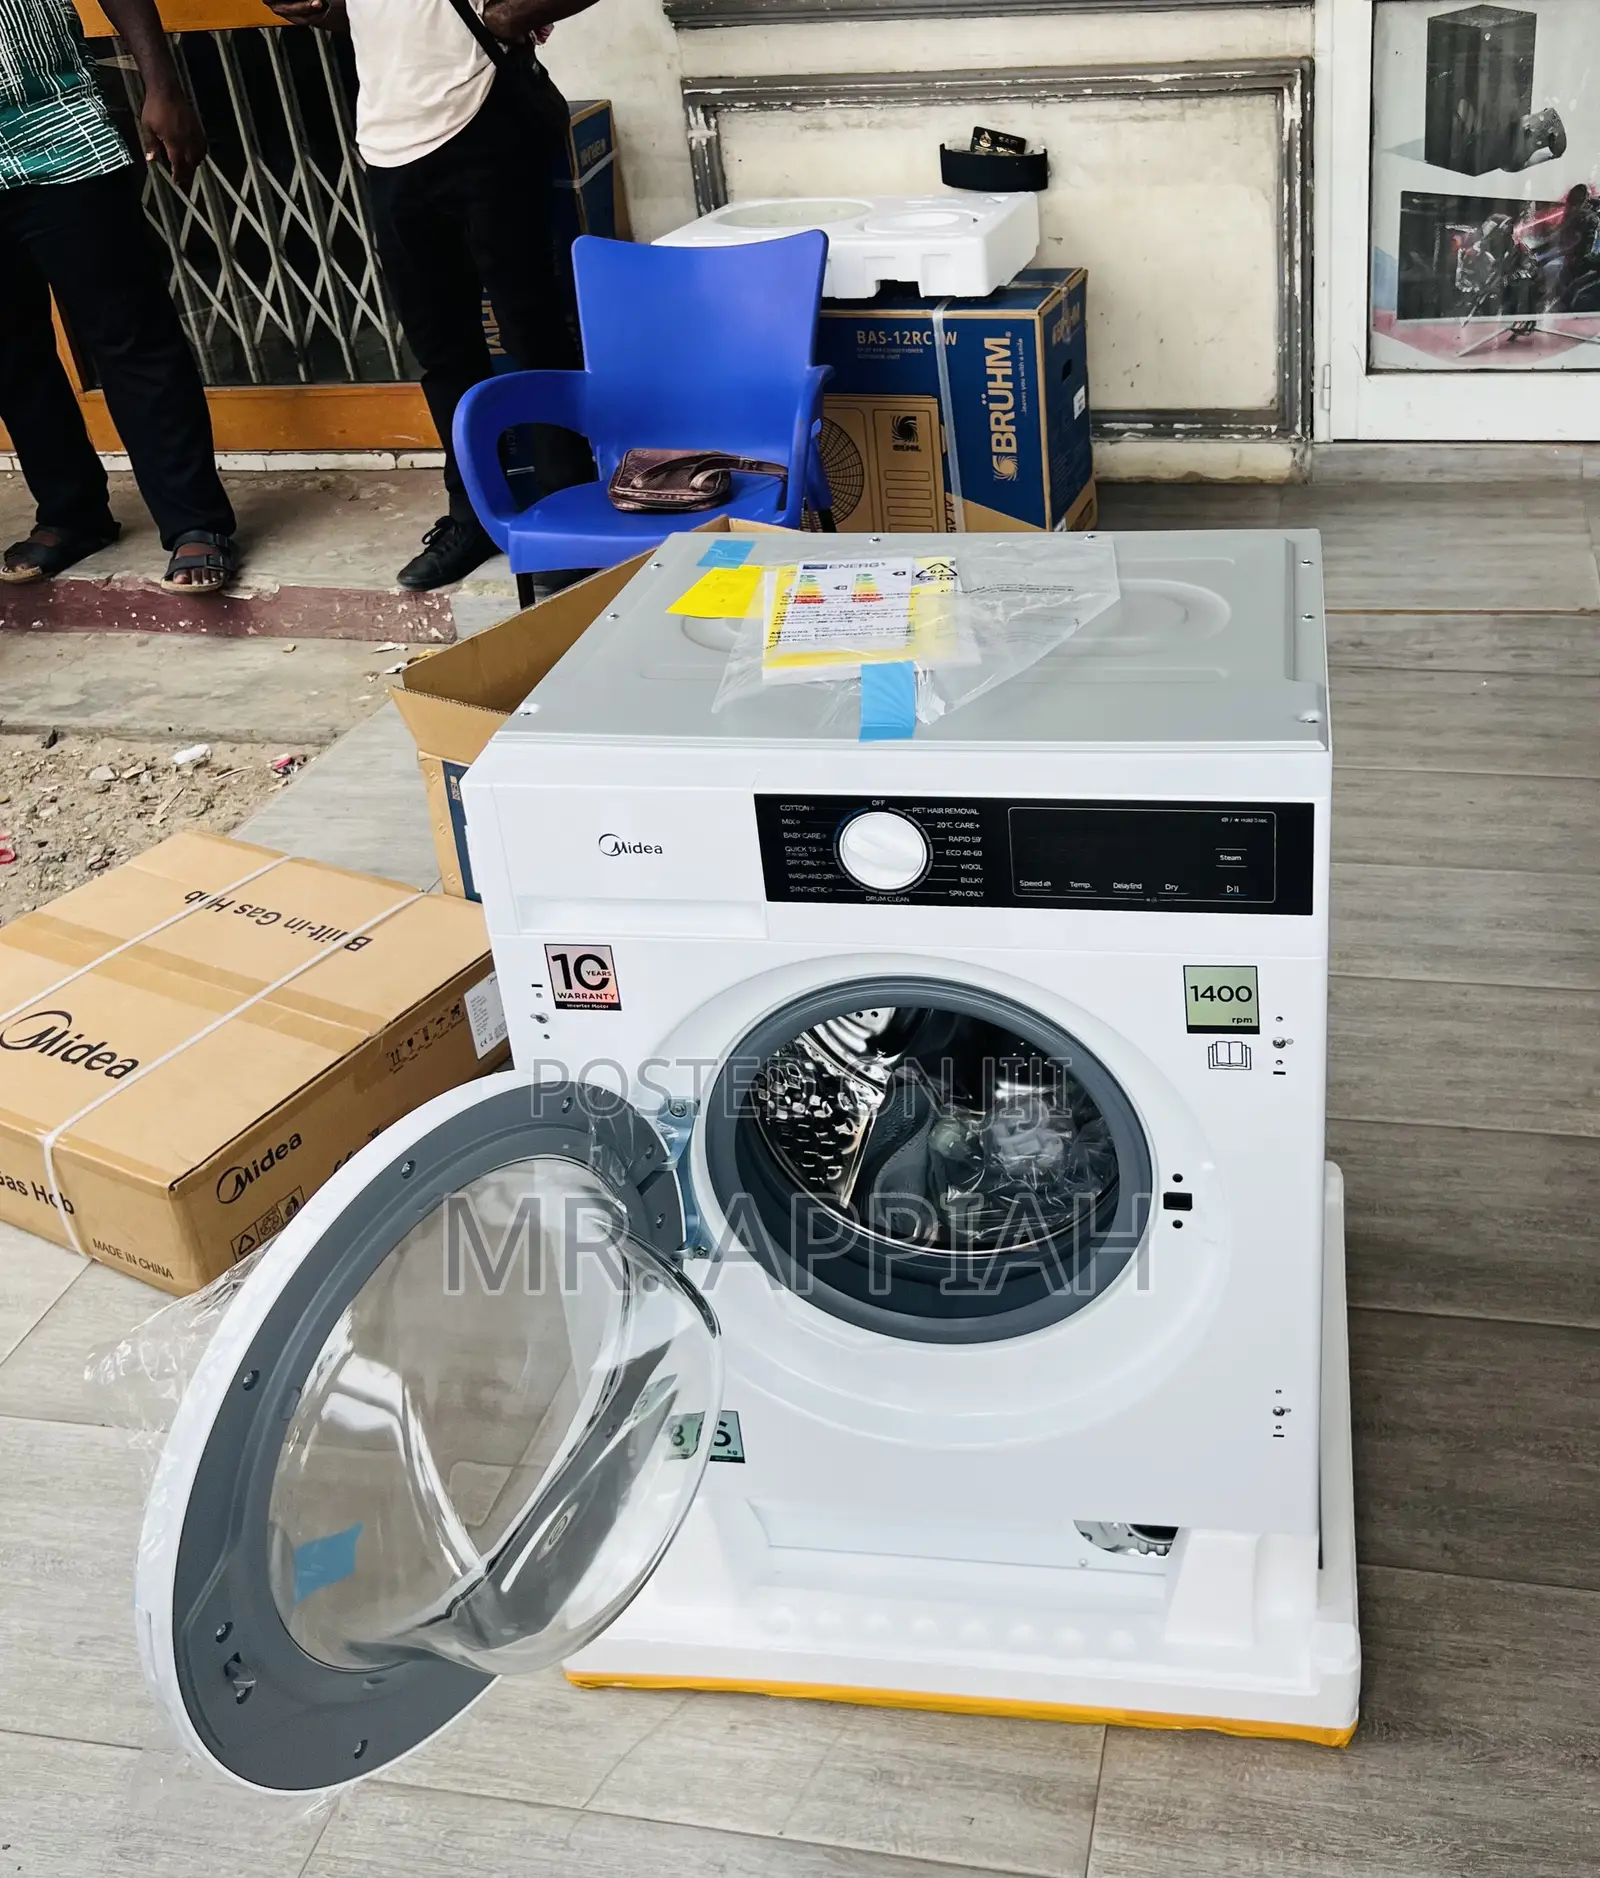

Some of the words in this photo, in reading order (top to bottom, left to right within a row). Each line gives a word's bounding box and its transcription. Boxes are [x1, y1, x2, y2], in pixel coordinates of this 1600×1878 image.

[981, 337, 1018, 454] BRÜHM
[871, 799, 886, 807] OFF
[779, 804, 810, 812] COTTON
[912, 806, 926, 814] PET
[927, 807, 944, 815] HAIR
[944, 807, 980, 815] REMOVAL
[802, 832, 822, 840] CARE
[948, 835, 970, 843] RAPID
[598, 833, 664, 857] Midea
[945, 849, 962, 857] ECO
[960, 863, 984, 871] WOOL
[1019, 879, 1043, 888] Speed
[1069, 881, 1093, 889] Temp.
[1164, 883, 1179, 891] Dry
[948, 889, 965, 898] SPIN
[965, 890, 985, 898] ONLY
[233, 903, 283, 926] Gas
[551, 953, 610, 991] 10
[556, 992, 616, 1000] WARRANTY
[1190, 985, 1253, 1003] 1400
[0, 1010, 139, 1080] Midea
[216, 1132, 303, 1204] Midea
[92, 1238, 125, 1260] MADE
[126, 1252, 138, 1265] IN
[138, 1259, 175, 1280] CHINA
